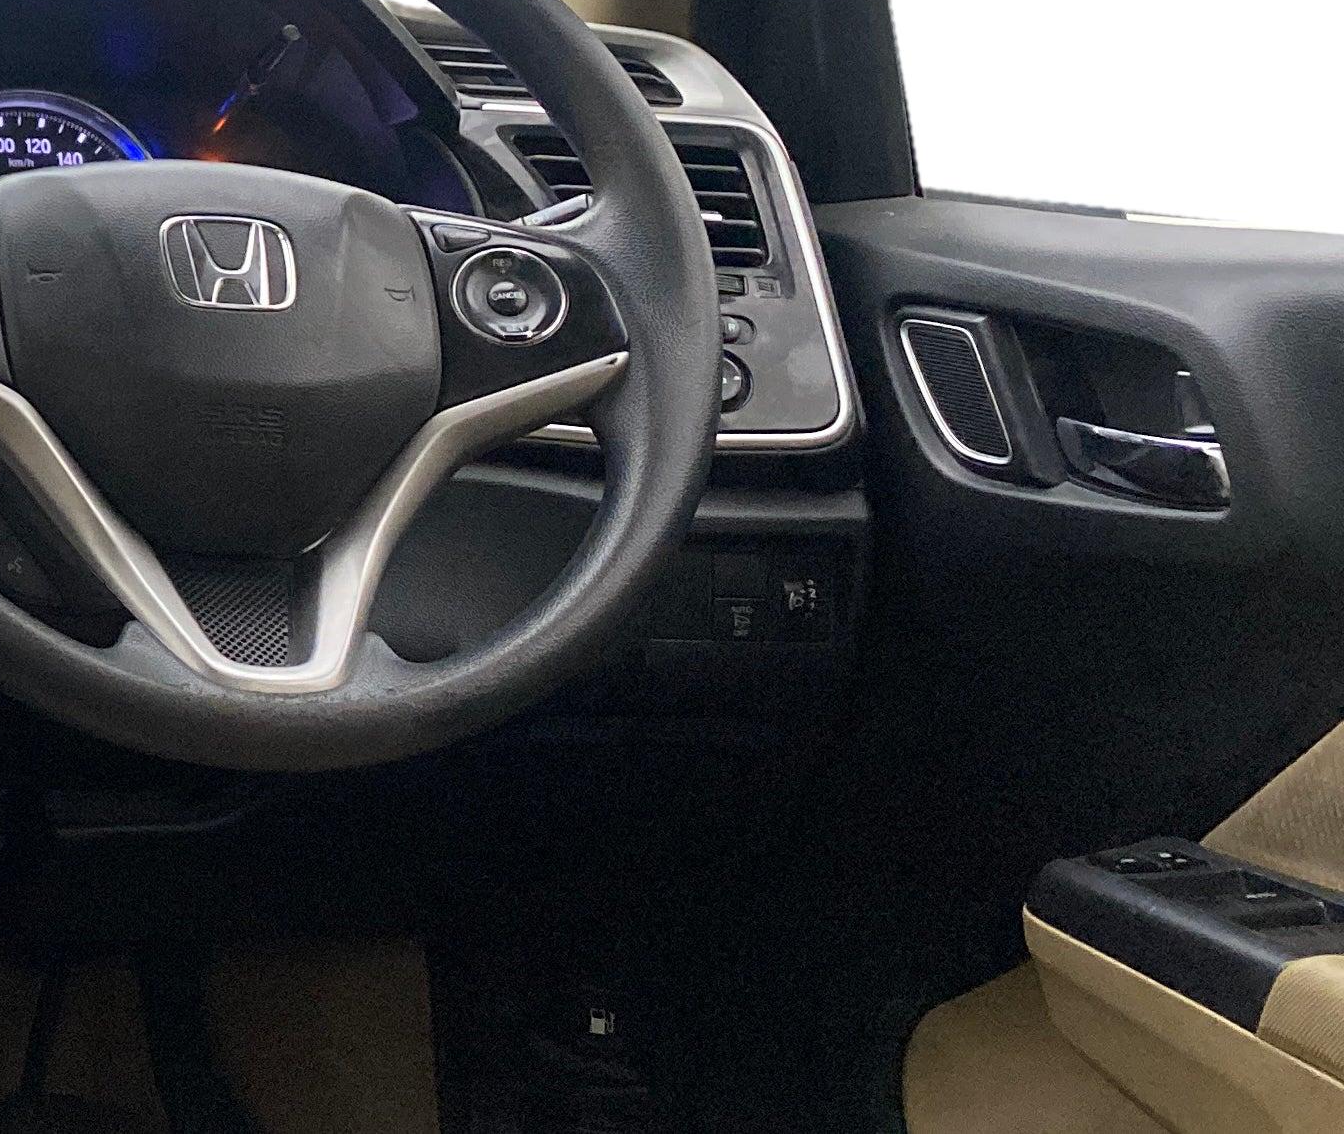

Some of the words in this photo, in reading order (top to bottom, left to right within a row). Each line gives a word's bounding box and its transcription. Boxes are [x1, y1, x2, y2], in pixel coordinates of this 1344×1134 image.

[25, 138, 51, 154] 120
[8, 157, 34, 168] km/h
[57, 152, 83, 165] 140
